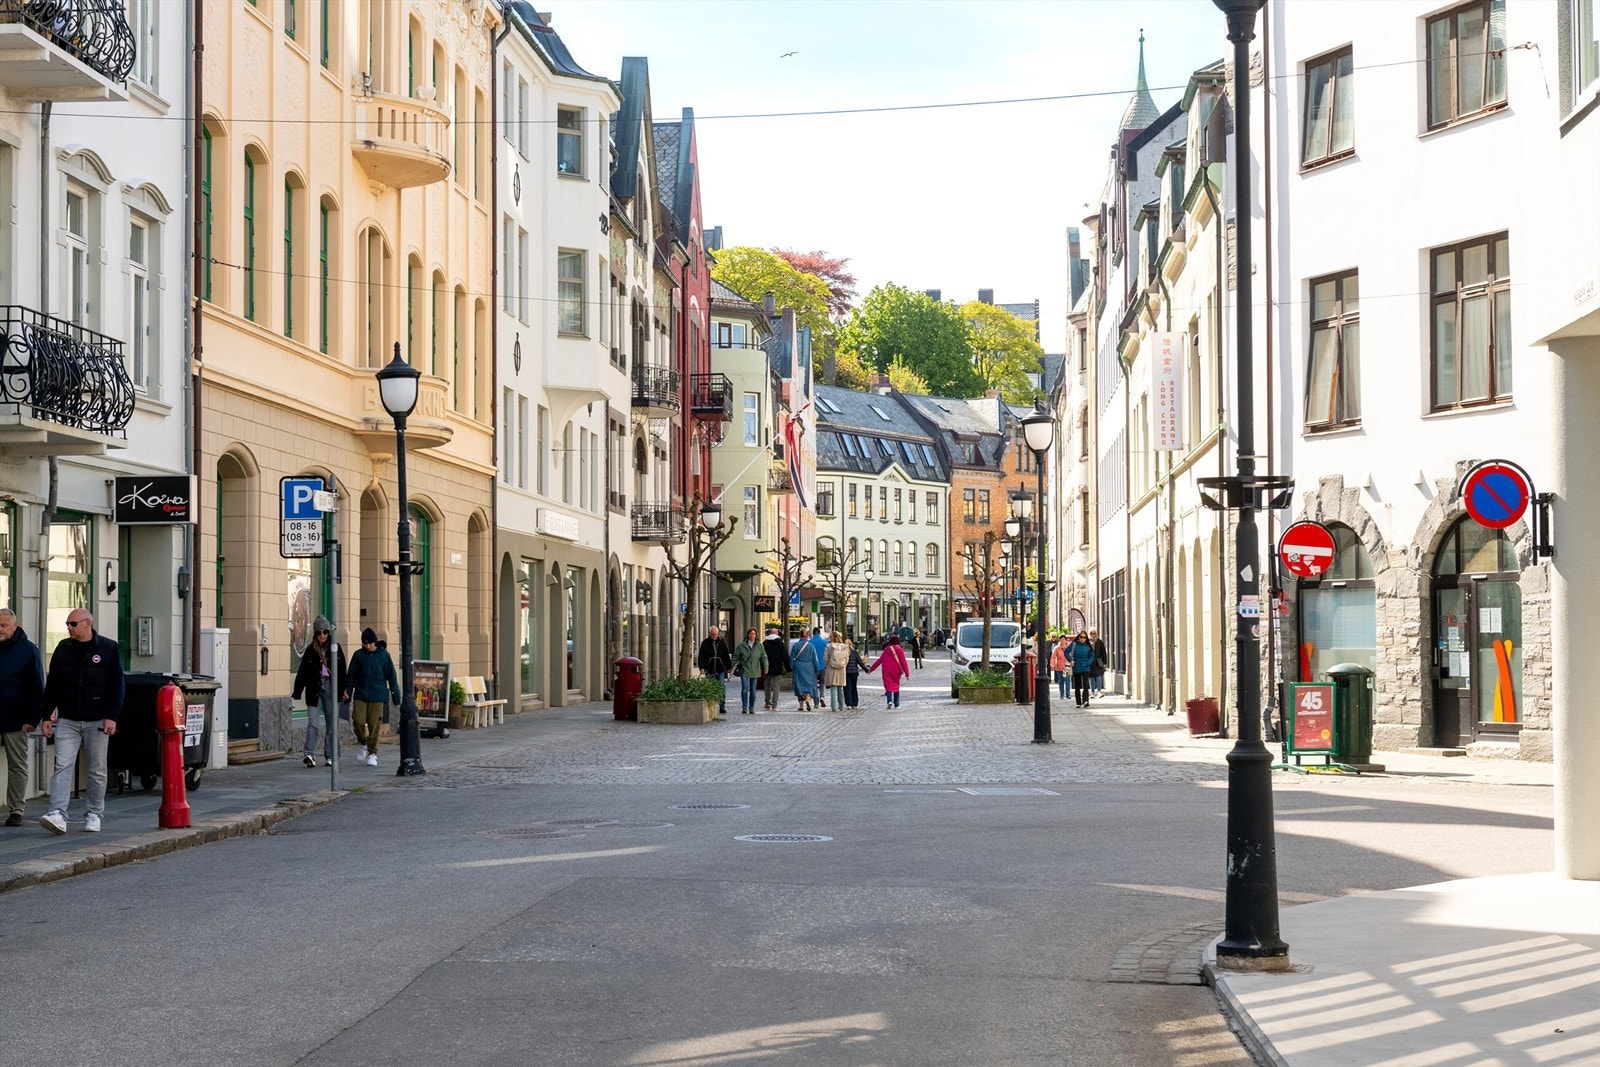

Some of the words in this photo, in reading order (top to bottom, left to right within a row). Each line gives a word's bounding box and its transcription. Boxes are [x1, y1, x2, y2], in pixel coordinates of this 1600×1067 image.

[293, 485, 313, 514] P
[290, 522, 302, 531] 08
[308, 522, 317, 531] 16
[286, 532, 302, 542] (08
[308, 532, 320, 542] 16)
[1300, 691, 1323, 710] 45
